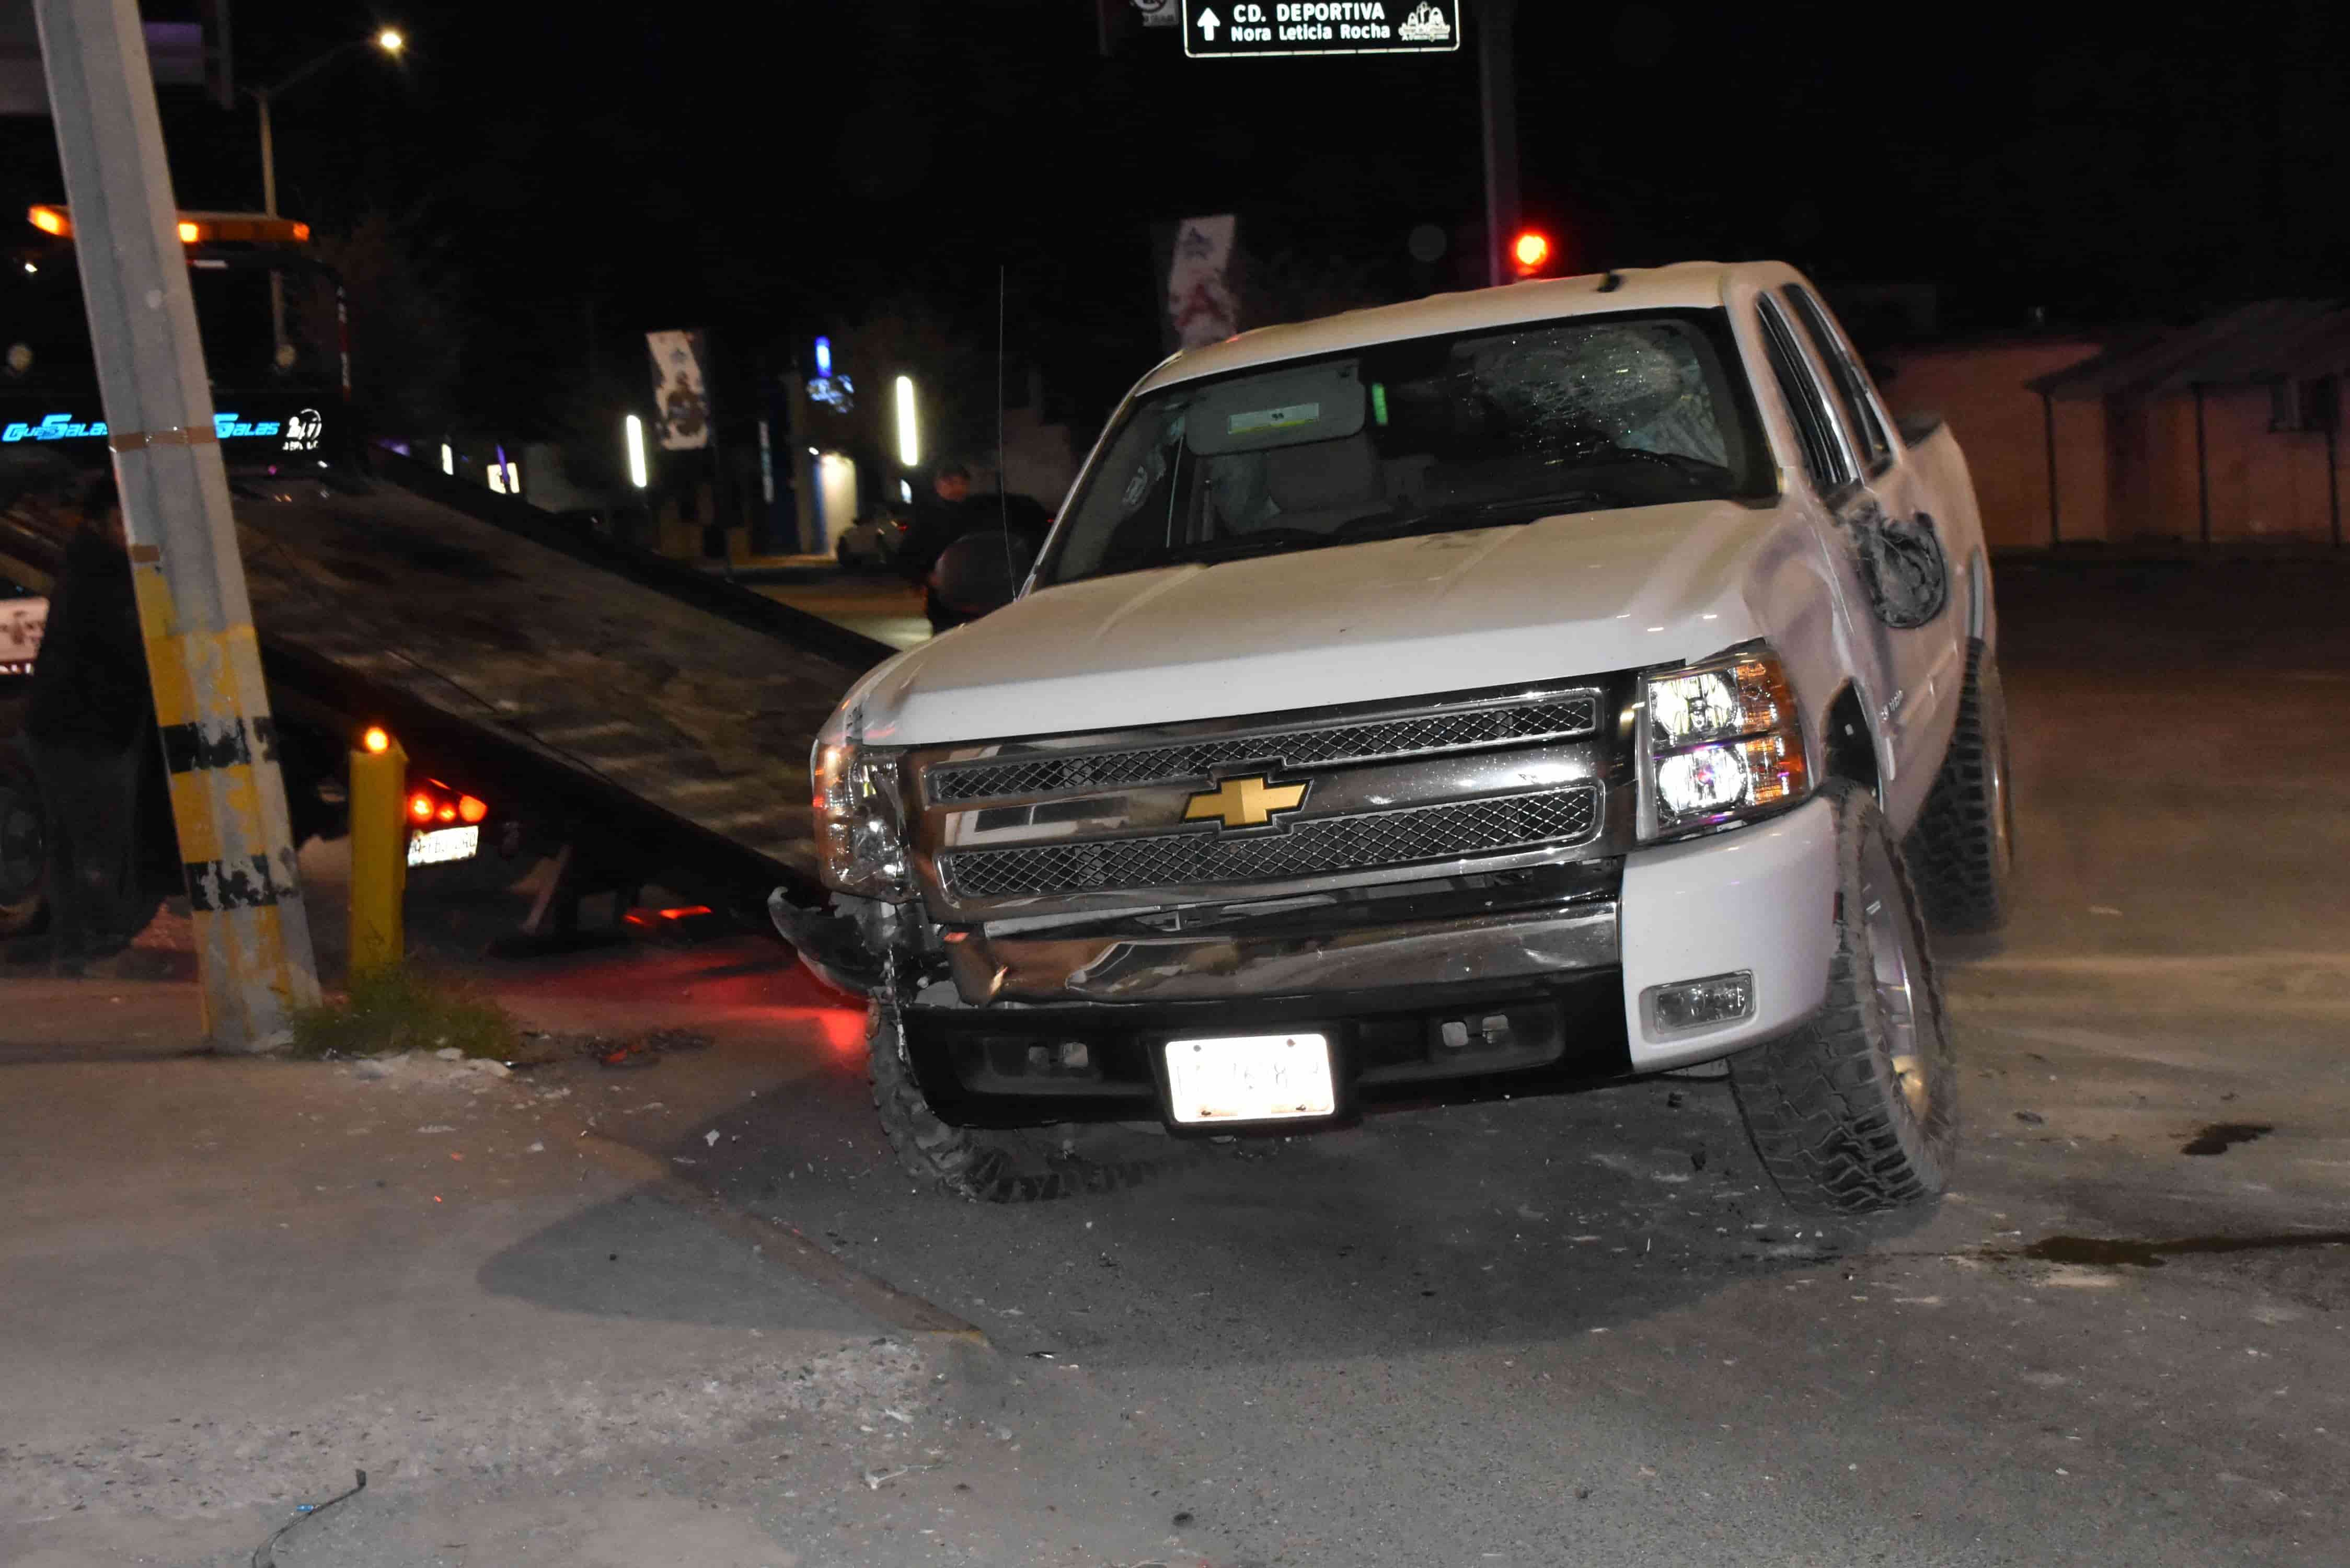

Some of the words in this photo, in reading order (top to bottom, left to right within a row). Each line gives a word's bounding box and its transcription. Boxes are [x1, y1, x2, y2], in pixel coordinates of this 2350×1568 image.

[1233, 4, 1266, 23] CD.
[1276, 2, 1385, 21] DEPORTIVA
[1231, 26, 1272, 42] Nora
[1279, 23, 1332, 41] Leticia
[1340, 22, 1390, 39] Rocha
